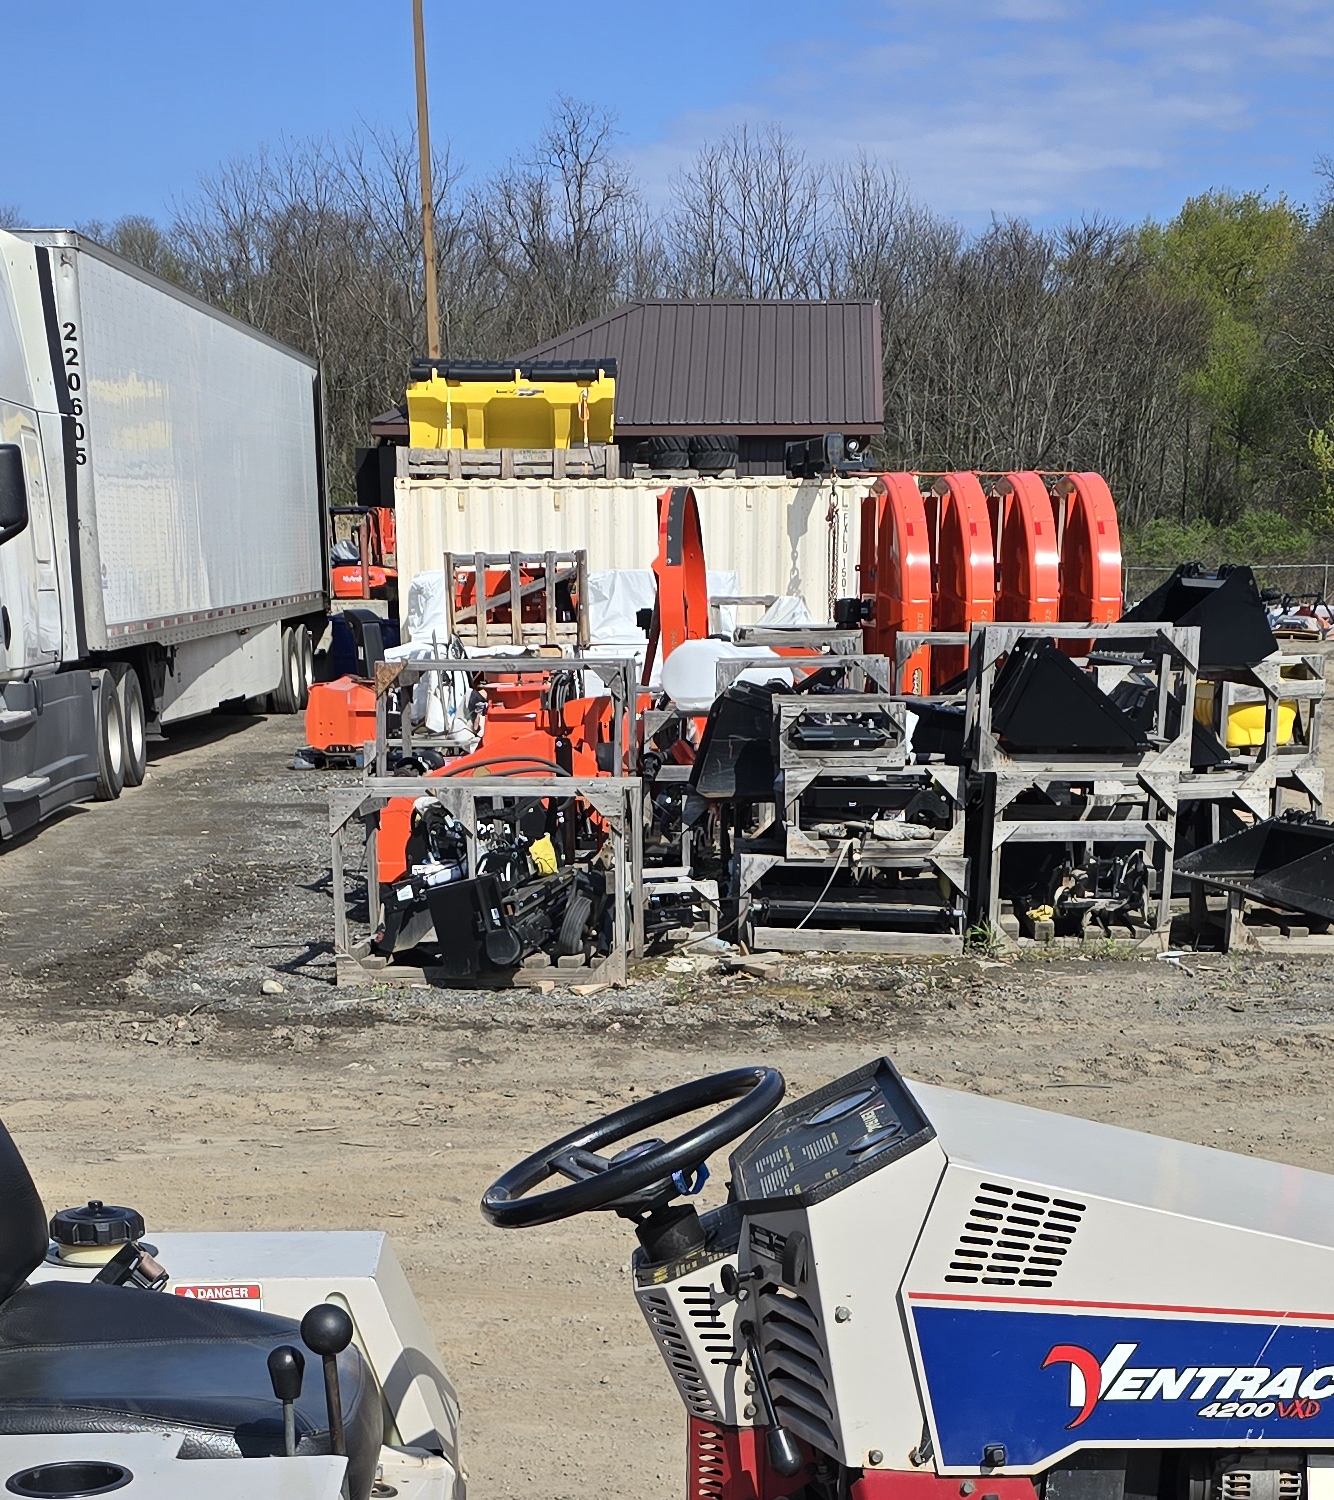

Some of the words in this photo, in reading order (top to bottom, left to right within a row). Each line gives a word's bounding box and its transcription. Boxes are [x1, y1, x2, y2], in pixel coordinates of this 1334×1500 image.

[62, 322, 87, 466] 220605
[197, 1288, 249, 1299] DANGER
[1198, 1402, 1275, 1418] 4200
[1277, 1399, 1321, 1419] VXD
